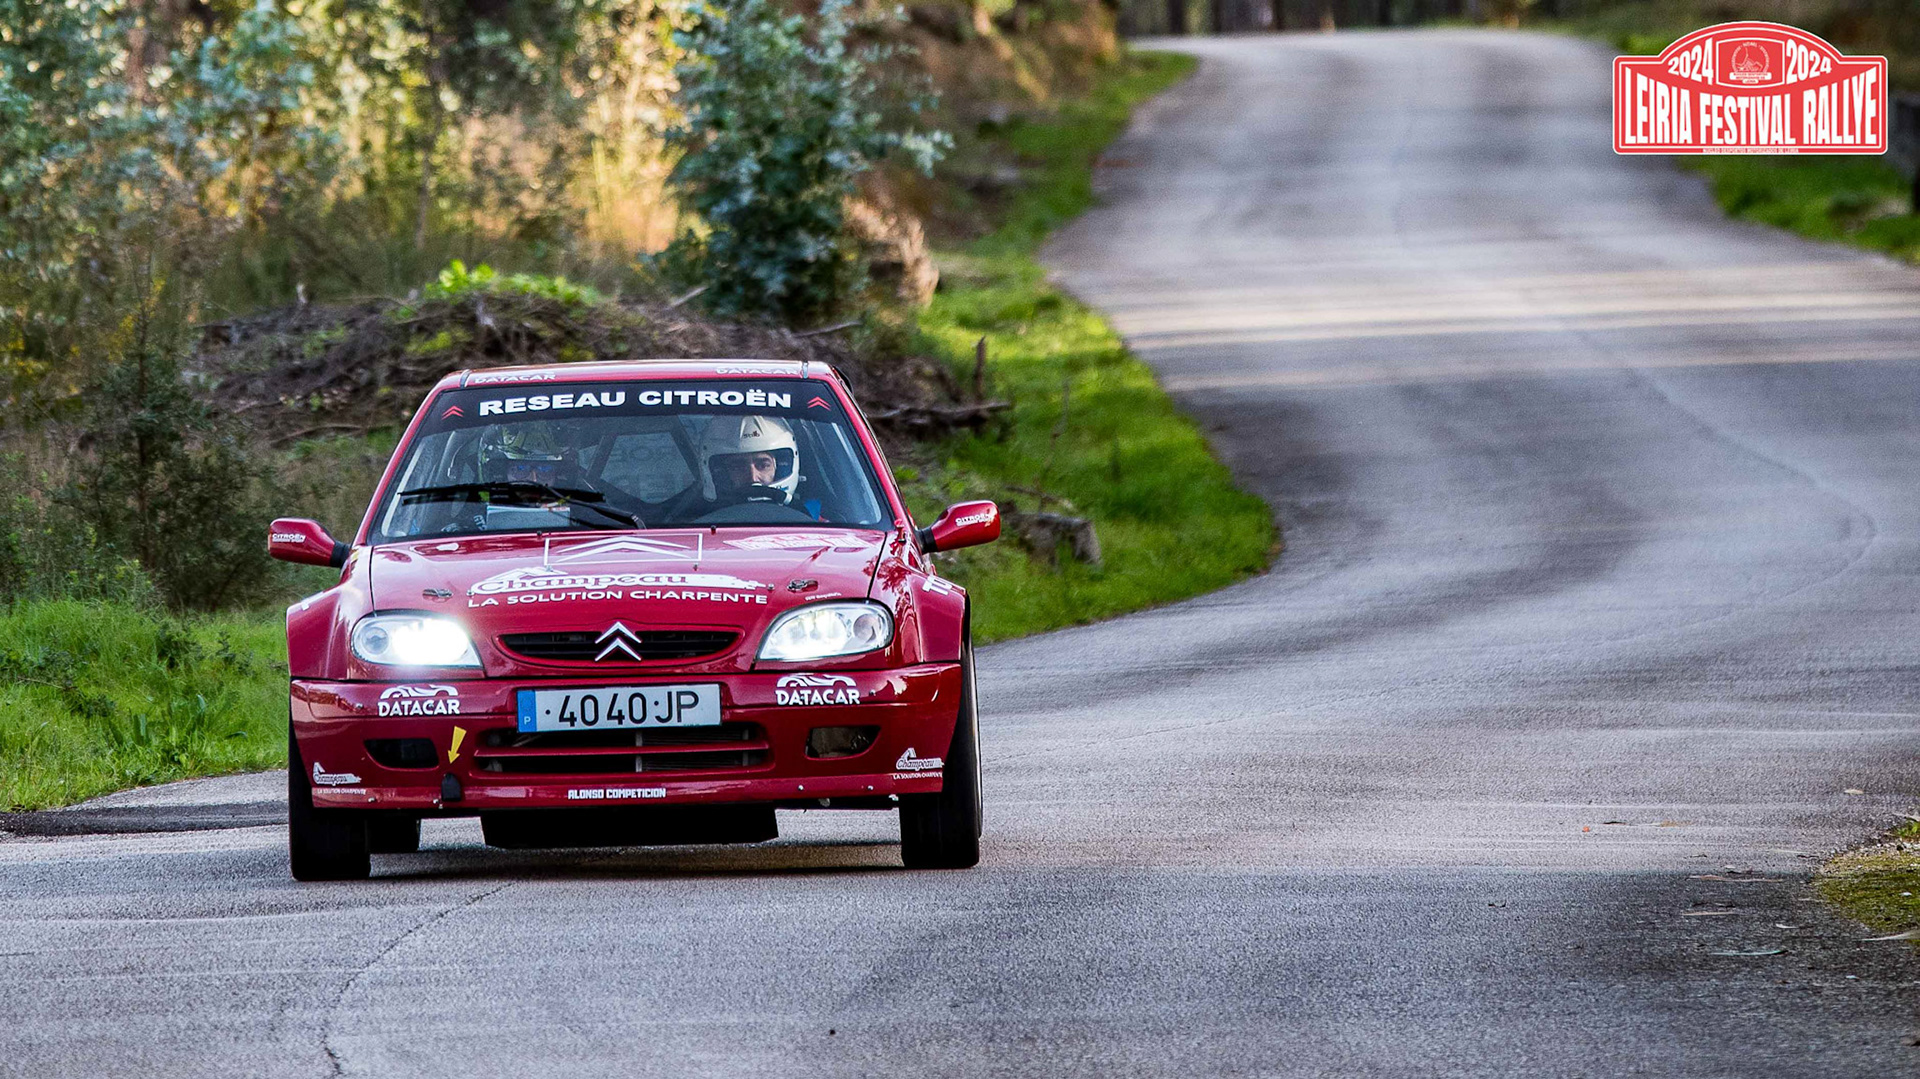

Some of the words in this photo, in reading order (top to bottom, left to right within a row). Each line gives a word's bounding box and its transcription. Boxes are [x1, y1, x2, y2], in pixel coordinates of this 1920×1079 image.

[479, 391, 626, 416] RESEAU
[638, 388, 791, 408] CITROËN
[476, 574, 690, 591] Champeau
[468, 597, 499, 608] LA
[507, 591, 623, 605] SOLUTION
[630, 590, 768, 605] CHARPENTE
[775, 688, 860, 706] DATACAR
[377, 699, 460, 717] DATACAR
[523, 716, 531, 725] P
[568, 789, 604, 800] ALONSO
[606, 788, 667, 799] COMPETICION
